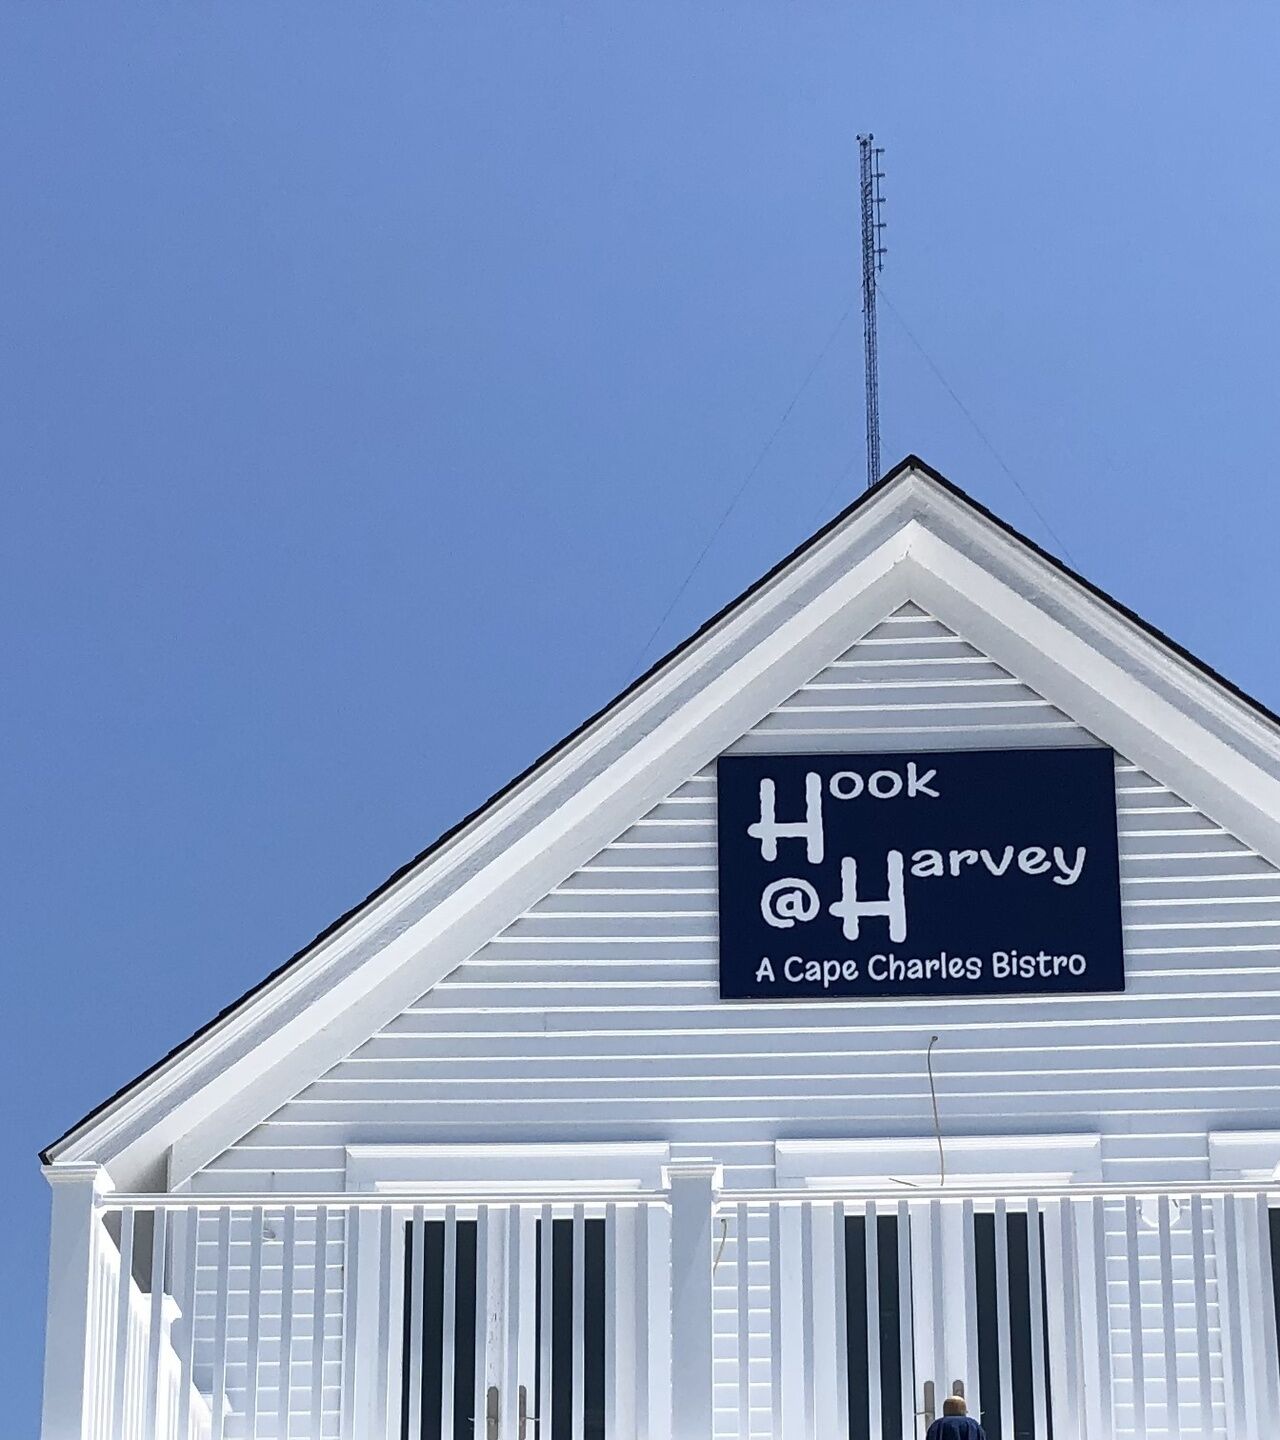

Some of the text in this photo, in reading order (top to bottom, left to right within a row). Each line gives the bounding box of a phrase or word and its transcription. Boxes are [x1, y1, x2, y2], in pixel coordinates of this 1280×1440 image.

[747, 761, 940, 865] Hook
[755, 950, 1087, 989] A Cape Charles Bistro
